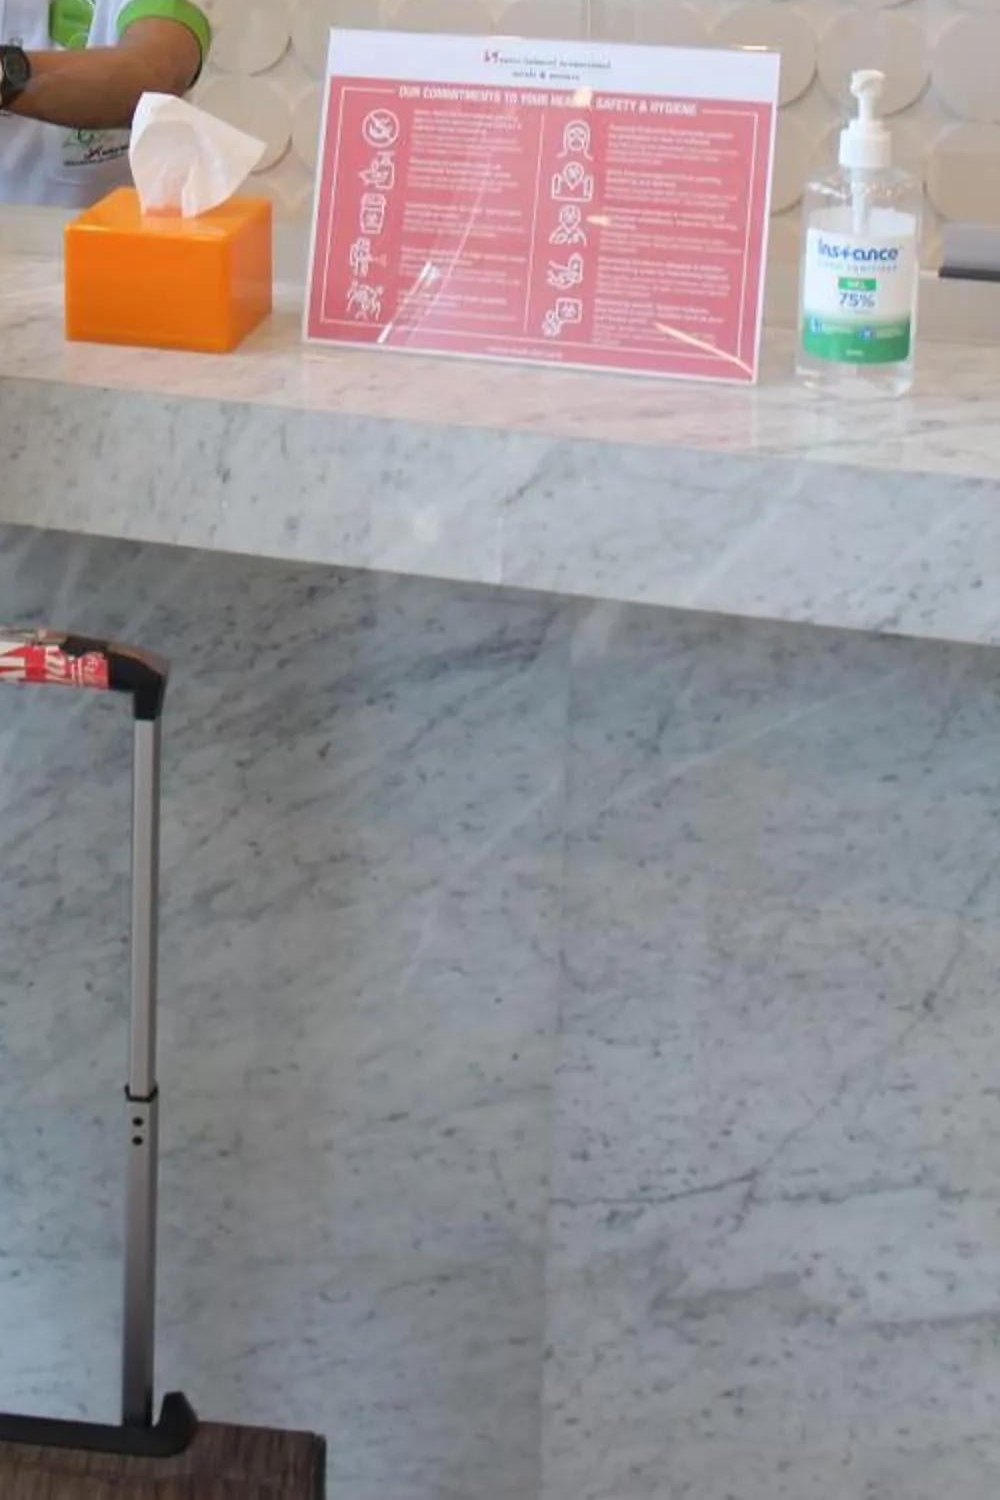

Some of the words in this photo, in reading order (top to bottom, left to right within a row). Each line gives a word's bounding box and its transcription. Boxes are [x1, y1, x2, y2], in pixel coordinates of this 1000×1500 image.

[399, 86, 421, 99] OUR
[504, 91, 517, 104] TO
[596, 97, 636, 112] SAFETY
[840, 292, 876, 308] 75%
